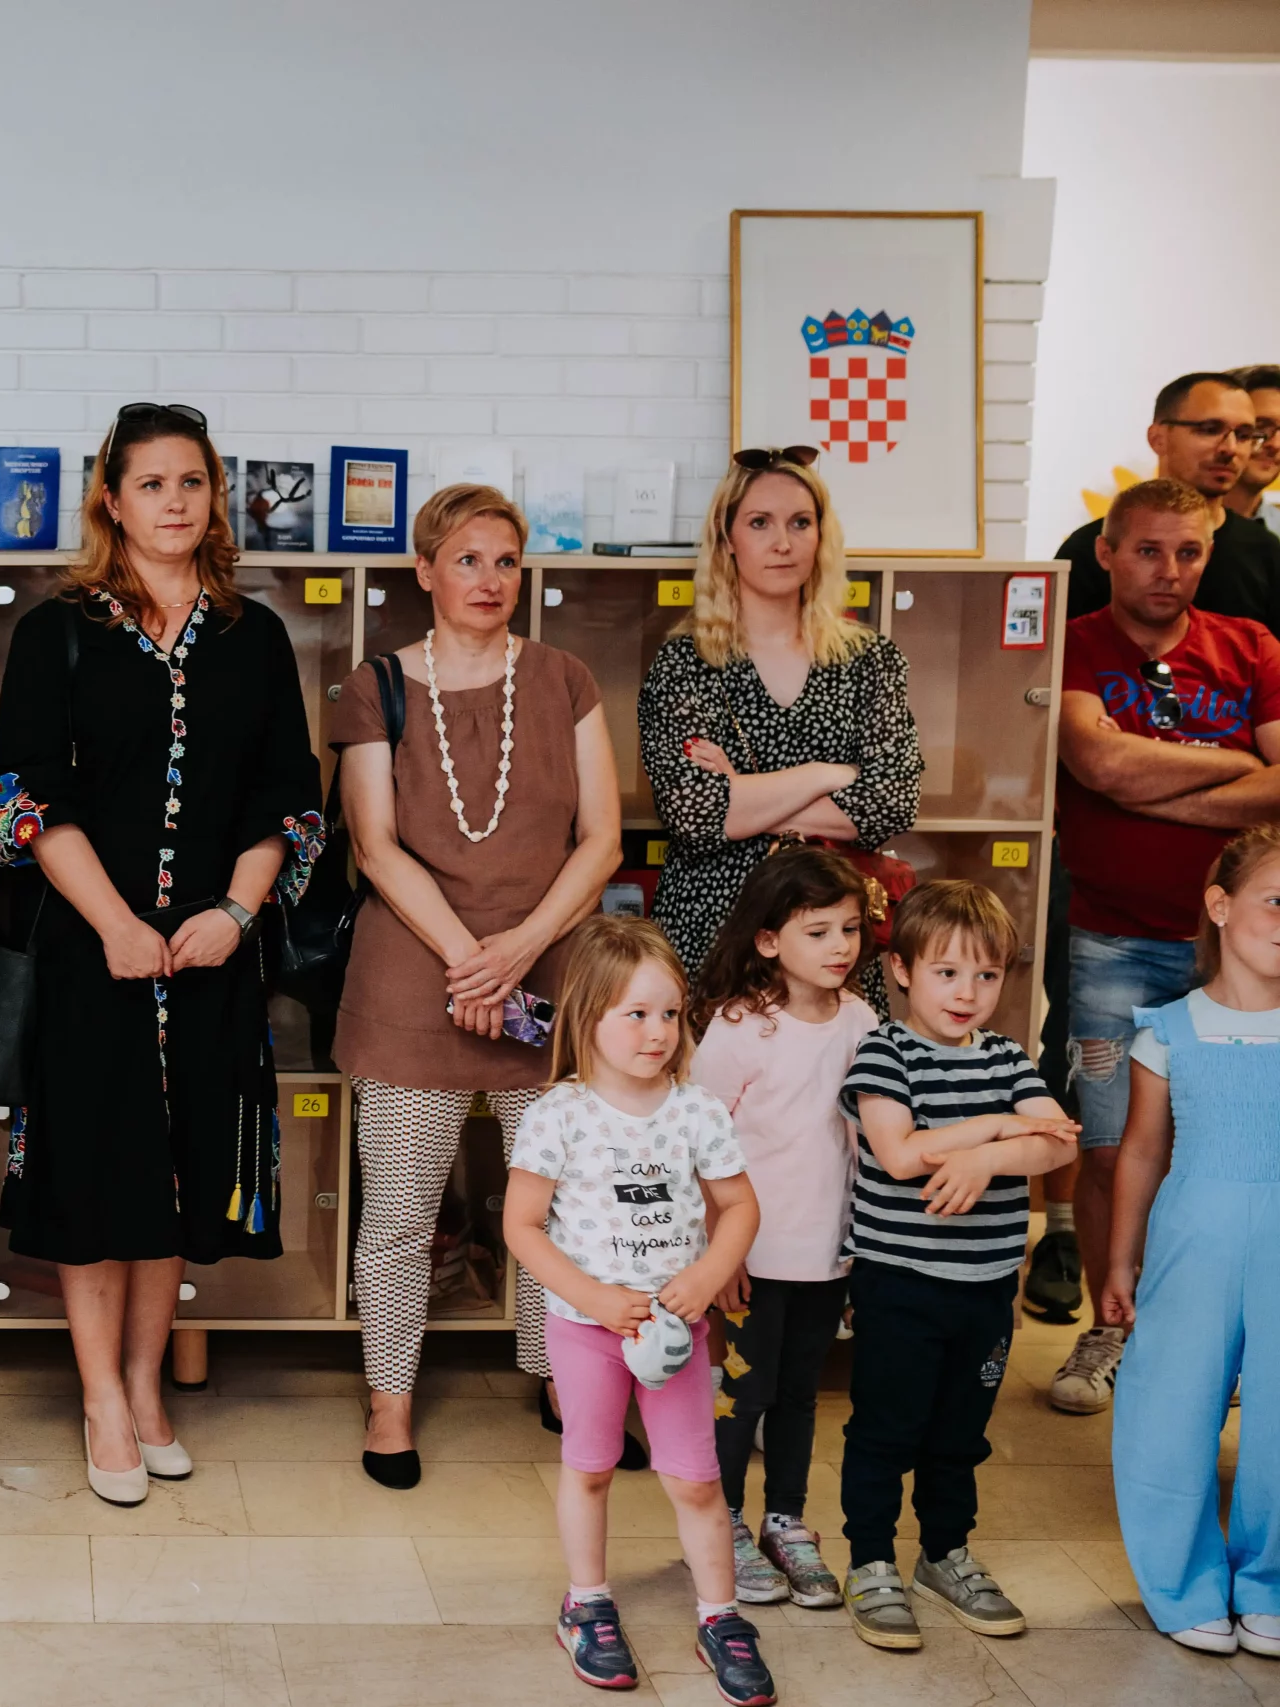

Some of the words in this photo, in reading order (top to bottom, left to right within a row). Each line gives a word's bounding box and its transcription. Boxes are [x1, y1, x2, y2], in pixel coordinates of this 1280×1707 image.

[318, 584, 328, 598] 6
[671, 586, 681, 600] 8
[847, 587, 857, 601] 9
[1001, 847, 1020, 862] 20
[301, 1098, 320, 1112] 26
[631, 1162, 671, 1176] am
[623, 1186, 662, 1201] THE
